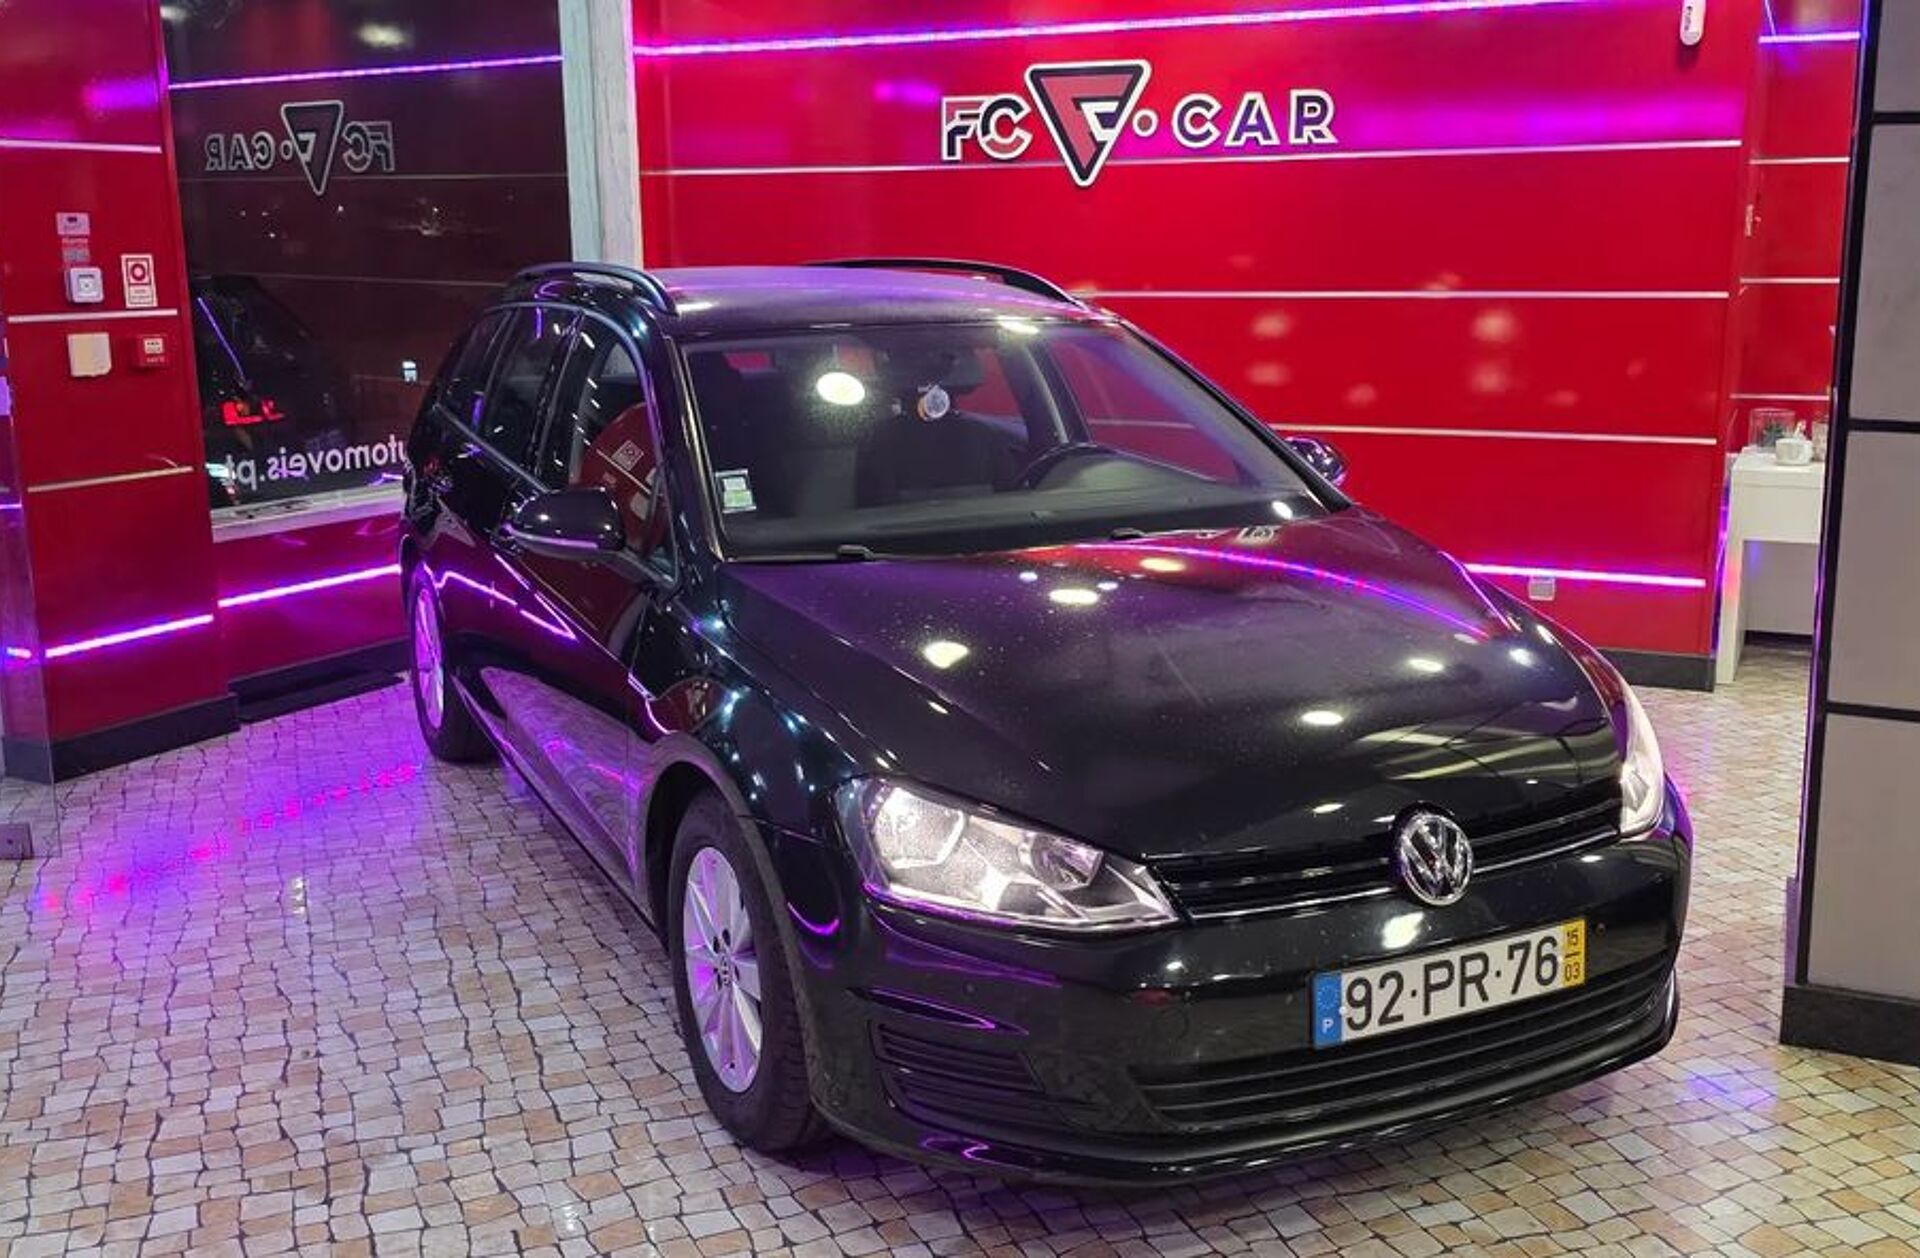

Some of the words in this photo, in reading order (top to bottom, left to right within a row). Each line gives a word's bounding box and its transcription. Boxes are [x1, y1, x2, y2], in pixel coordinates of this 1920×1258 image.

[941, 93, 1032, 161] FC
[1171, 88, 1338, 149] CAR
[1565, 929, 1579, 946] 15
[1563, 961, 1582, 982] 03
[1321, 1018, 1334, 1034] P
